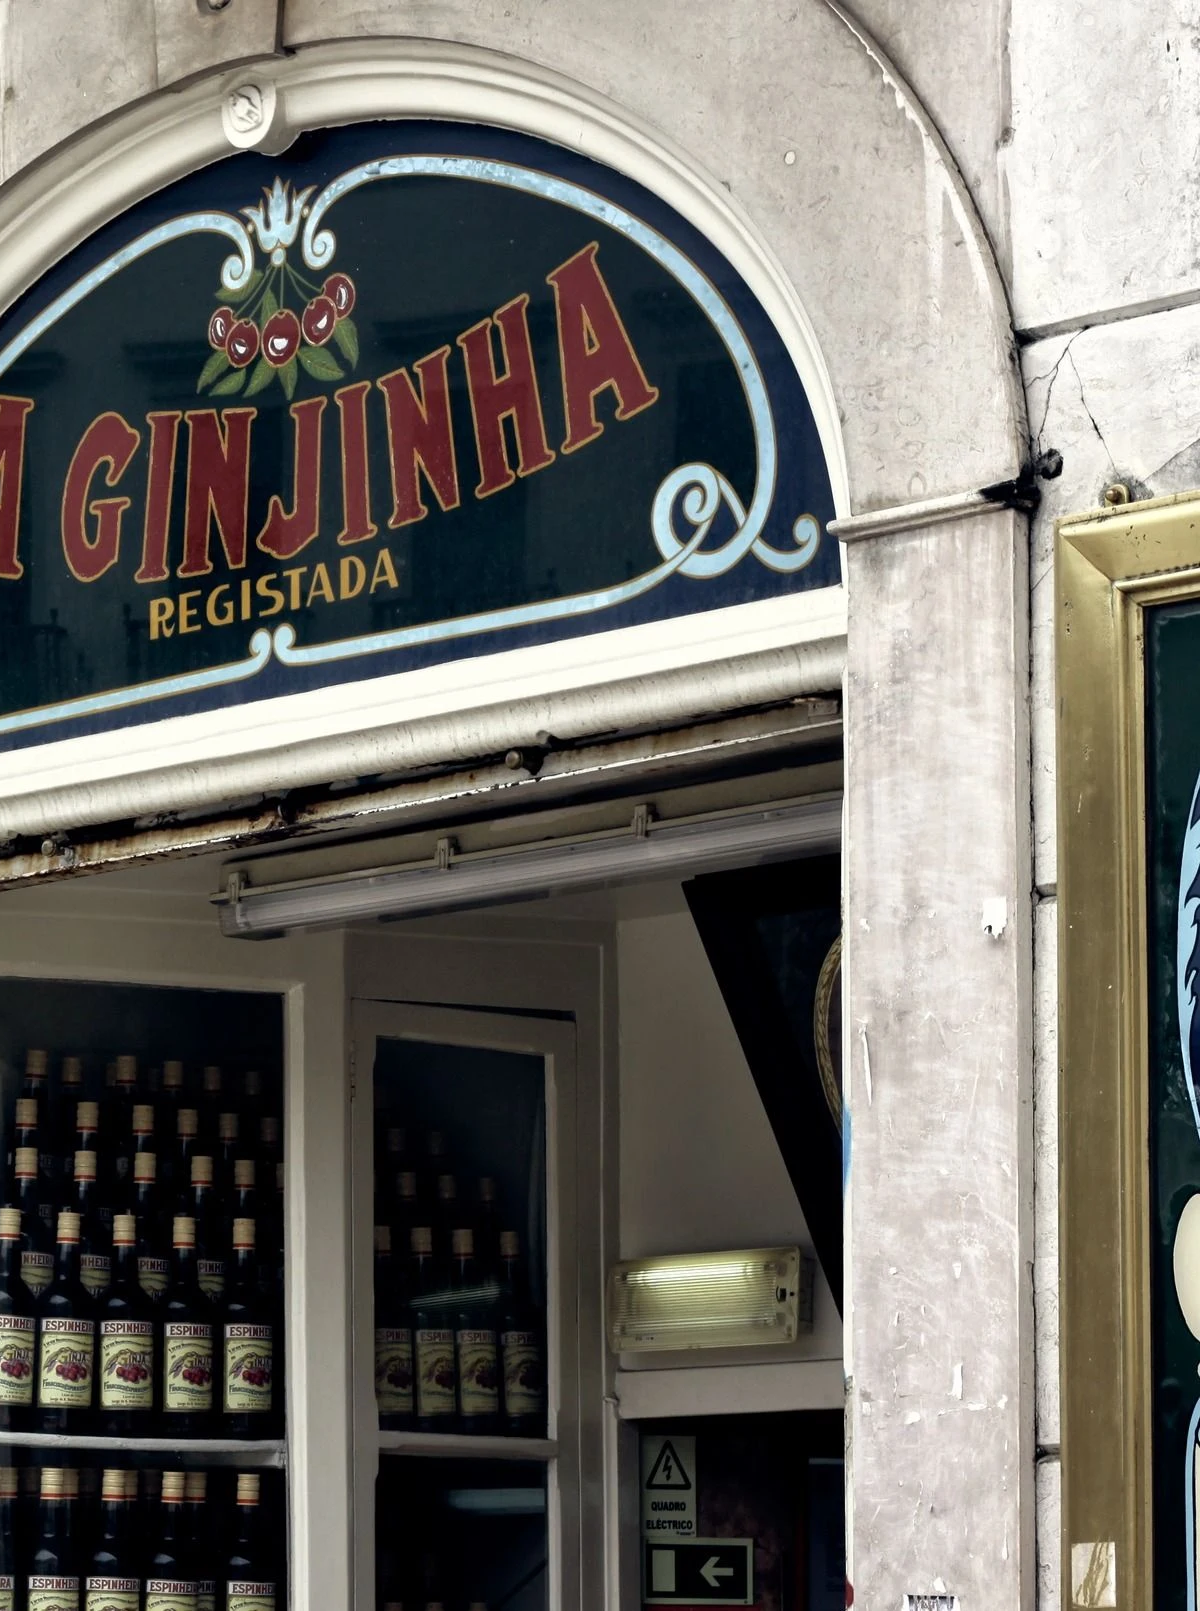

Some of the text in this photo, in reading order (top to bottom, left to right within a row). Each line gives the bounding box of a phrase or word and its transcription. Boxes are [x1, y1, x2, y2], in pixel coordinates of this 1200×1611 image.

[61, 241, 658, 583] GINJINHA
[149, 546, 400, 641] REGISTADA
[646, 1518, 693, 1530] ELÉCTRICO
[651, 1501, 686, 1512] QUADRO
